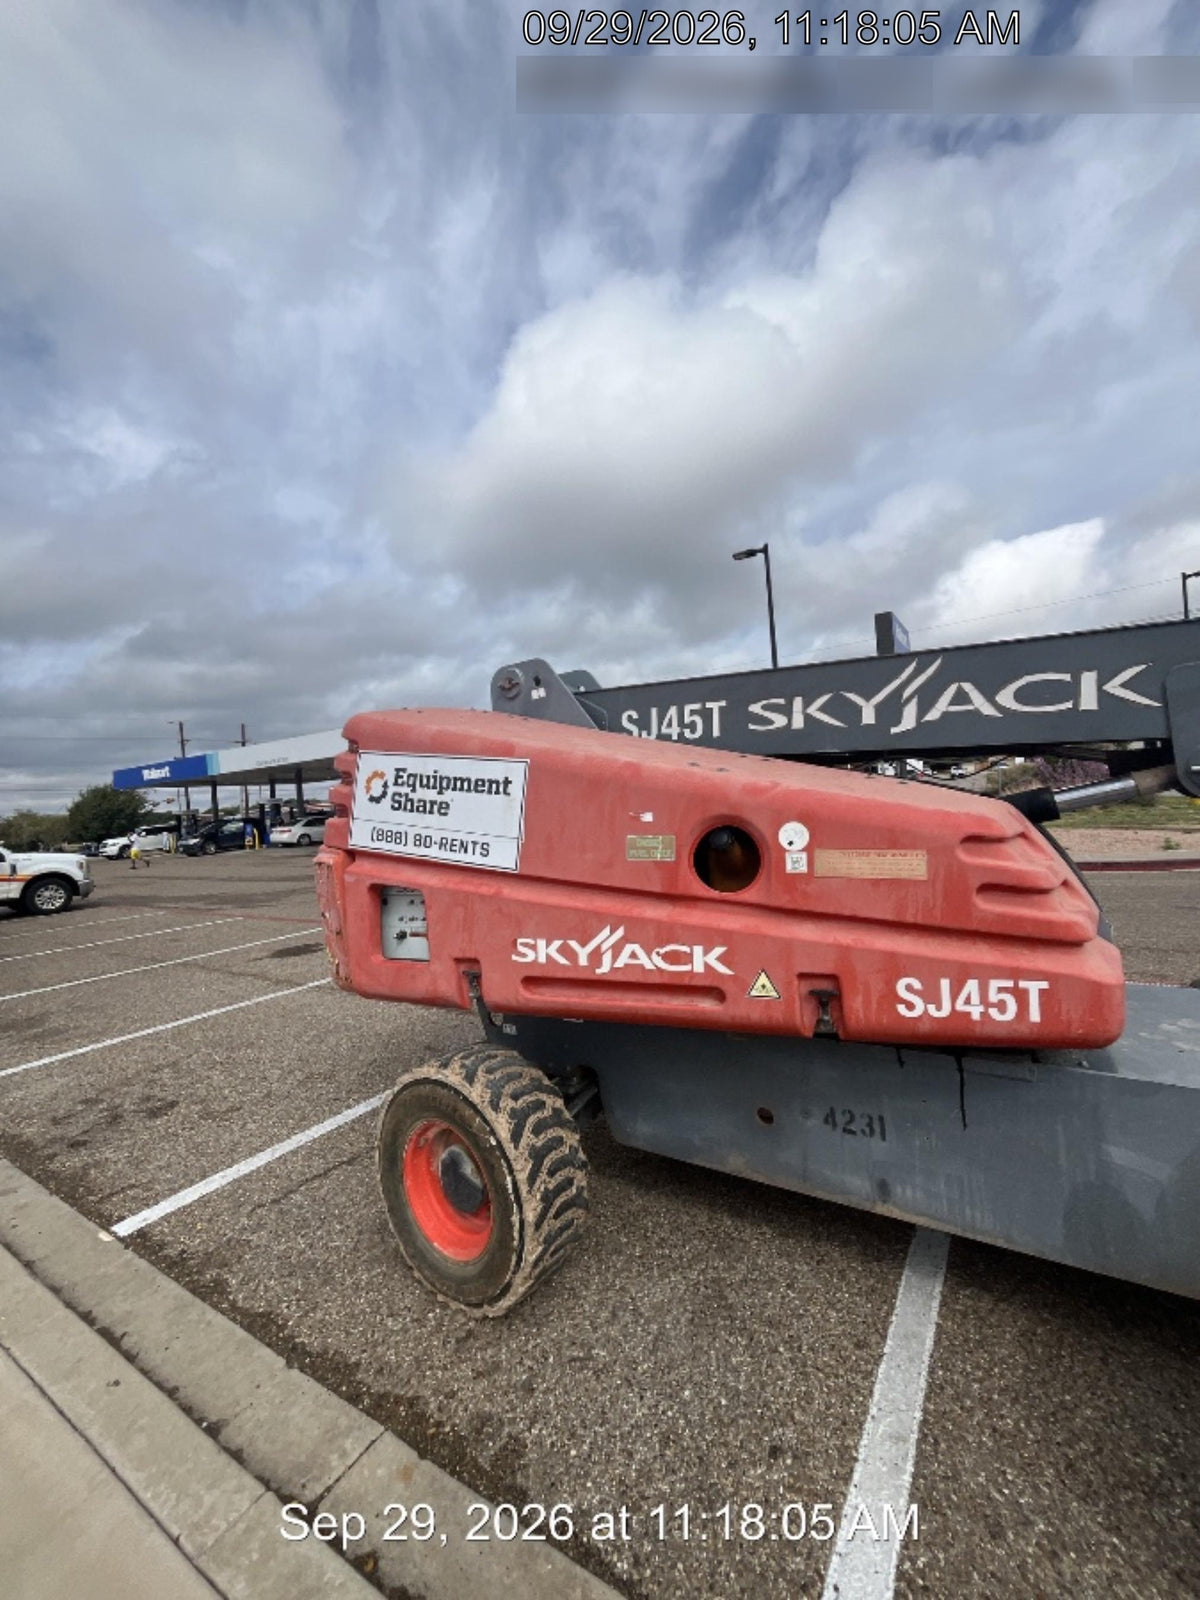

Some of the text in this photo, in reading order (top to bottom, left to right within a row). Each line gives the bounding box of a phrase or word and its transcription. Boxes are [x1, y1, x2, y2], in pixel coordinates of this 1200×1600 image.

[748, 656, 1162, 734] SKYJACK
[621, 700, 727, 740] SJ45T
[393, 768, 512, 796] Equipment
[391, 792, 450, 816] Share
[370, 826, 490, 858] (888) 80-RENTS
[511, 925, 735, 975] SKYJACK
[895, 977, 1050, 1023] SJ45T
[823, 1106, 886, 1142] 4231
